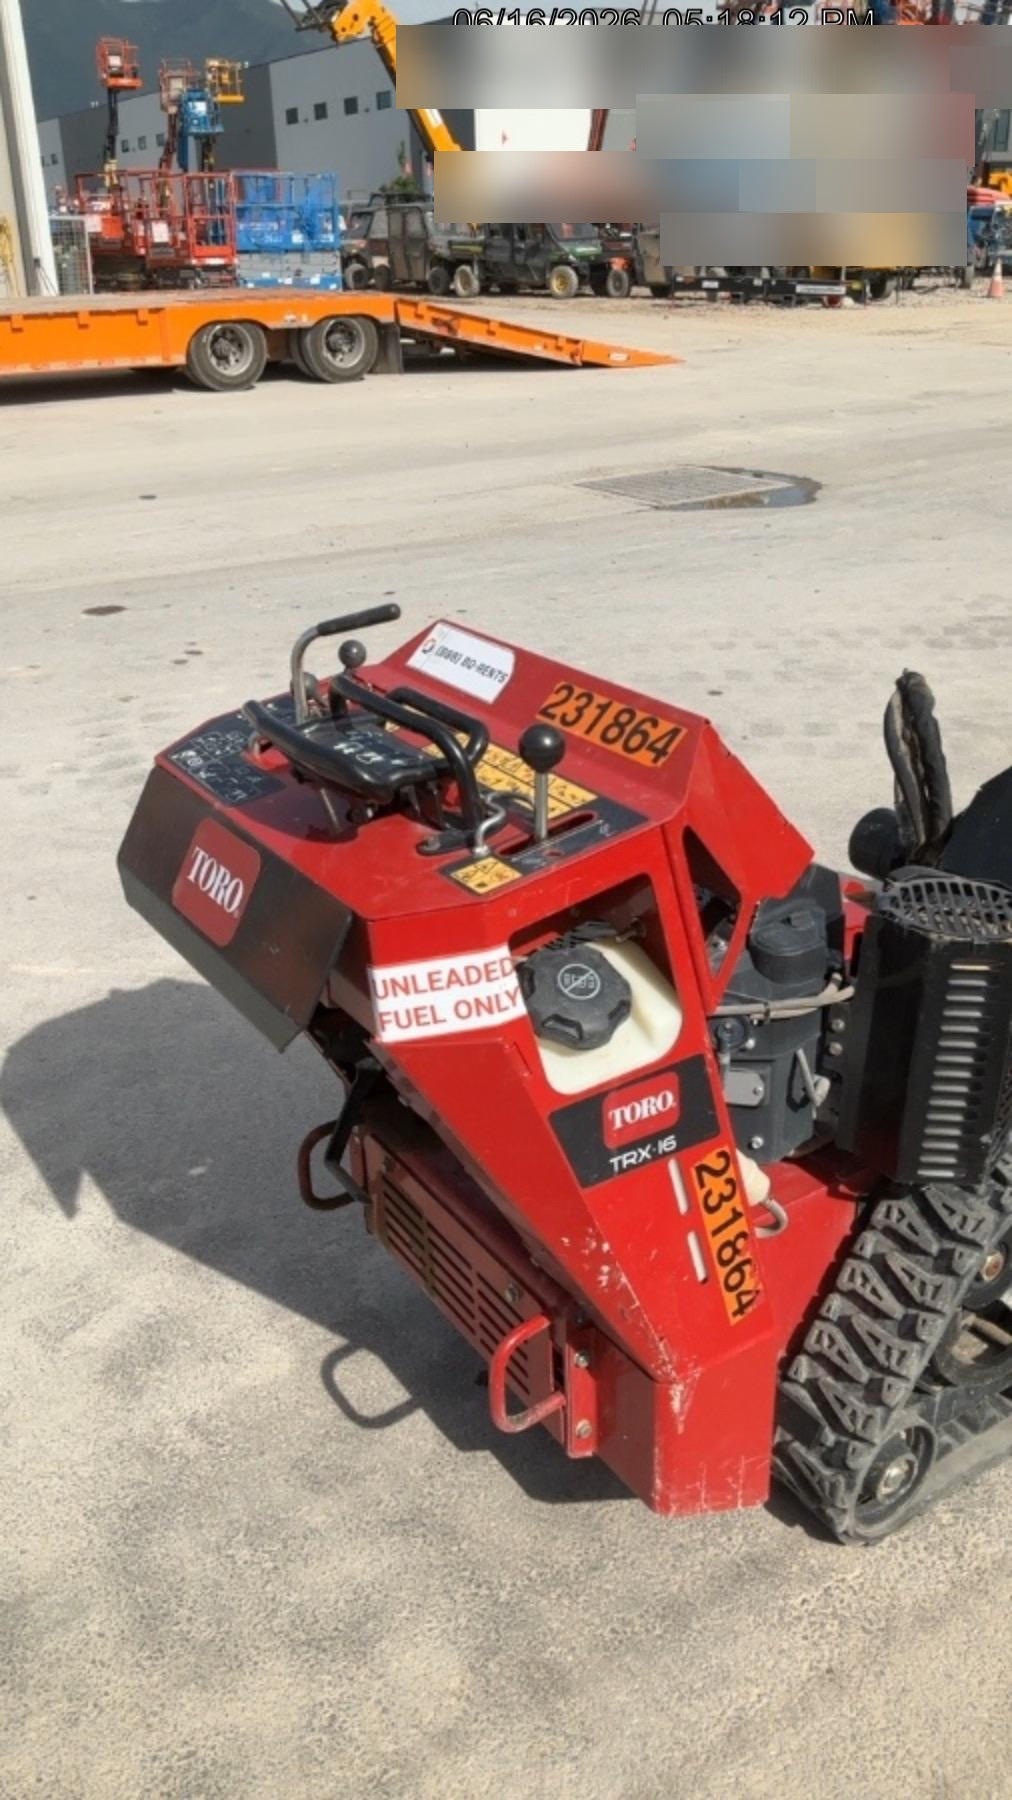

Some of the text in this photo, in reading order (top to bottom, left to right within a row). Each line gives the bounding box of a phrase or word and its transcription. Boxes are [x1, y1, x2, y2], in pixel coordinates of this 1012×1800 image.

[538, 684, 682, 763] 231864
[187, 846, 243, 913] TORO
[372, 957, 514, 999] UNLEADED
[378, 986, 520, 1032] FUEL ONLY
[608, 1089, 674, 1131] TORO
[695, 1150, 760, 1317] 231864
